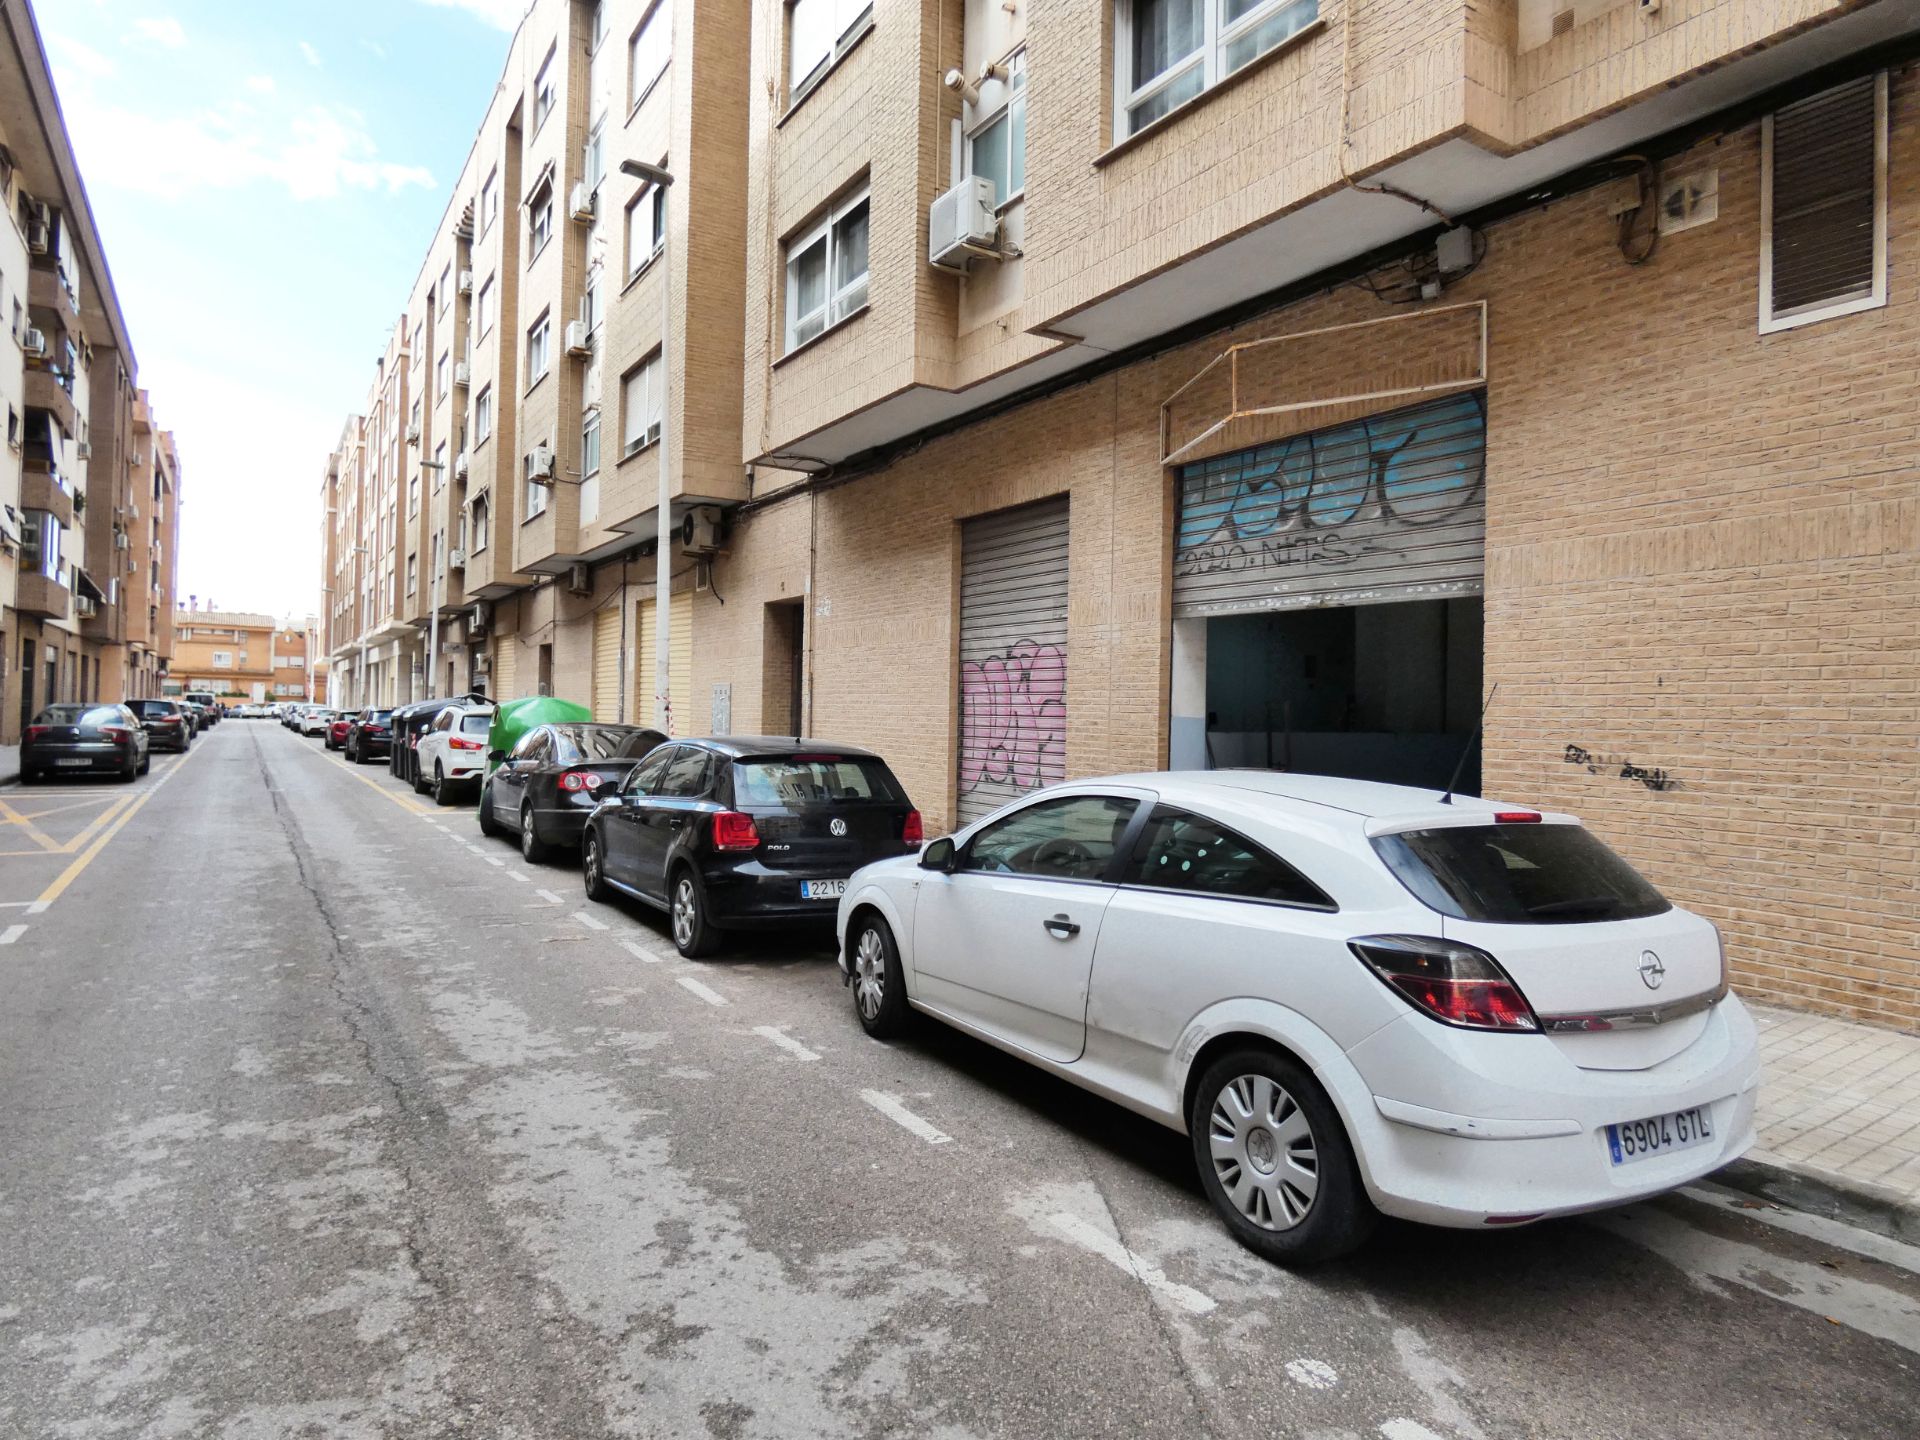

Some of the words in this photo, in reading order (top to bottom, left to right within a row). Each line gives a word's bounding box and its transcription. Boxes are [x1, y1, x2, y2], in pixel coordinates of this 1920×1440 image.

[811, 880, 846, 896] 2216
[1622, 1116, 1672, 1156] 6904
[1675, 1109, 1711, 1143] GTL
